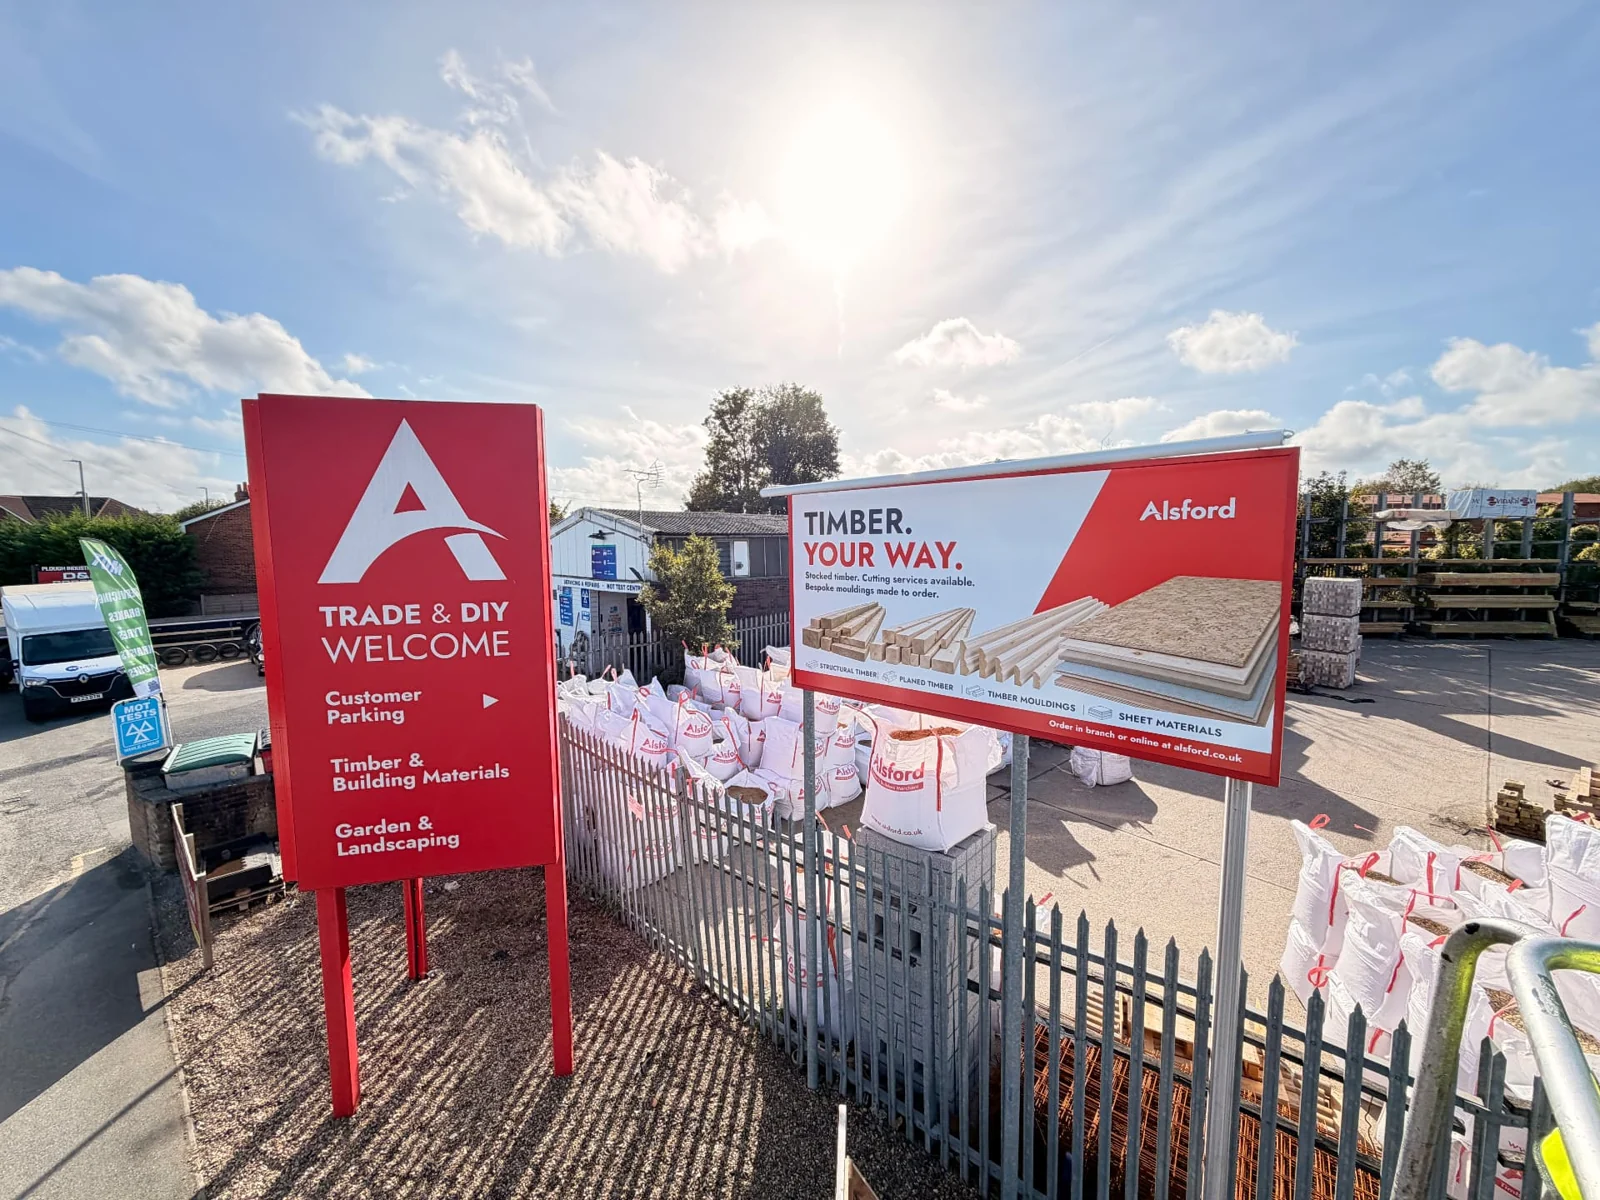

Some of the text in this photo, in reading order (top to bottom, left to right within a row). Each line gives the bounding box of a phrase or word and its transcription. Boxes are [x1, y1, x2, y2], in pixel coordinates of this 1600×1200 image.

[1139, 497, 1236, 521] Alsford
[804, 507, 912, 536] TIMBER.
[803, 541, 963, 570] YOUR WAY.
[805, 571, 975, 587] Stocked timber. Cutting services available.
[805, 583, 940, 598] Bespoke mouldings made to order.
[319, 601, 509, 627] TRADE & DIY
[321, 630, 510, 664] WELCOME
[819, 663, 877, 678] STRUCTURAL TIMBER
[899, 676, 954, 691] PLANED TIMBER
[123, 702, 150, 714] MOT
[325, 690, 422, 706] Customer
[987, 690, 1076, 713] TIMBER MOULDINGS
[118, 708, 157, 723] TESTS
[327, 706, 405, 725] Parking
[1118, 712, 1222, 737] SHEET MATERIALS
[1049, 719, 1243, 763] Order in branch or online at alsford.co.uk
[330, 753, 424, 774] Timber &
[873, 753, 925, 782] Alsford
[333, 763, 510, 792] Building Materials
[335, 816, 433, 839] Garden &
[337, 833, 460, 857] Landscaping
